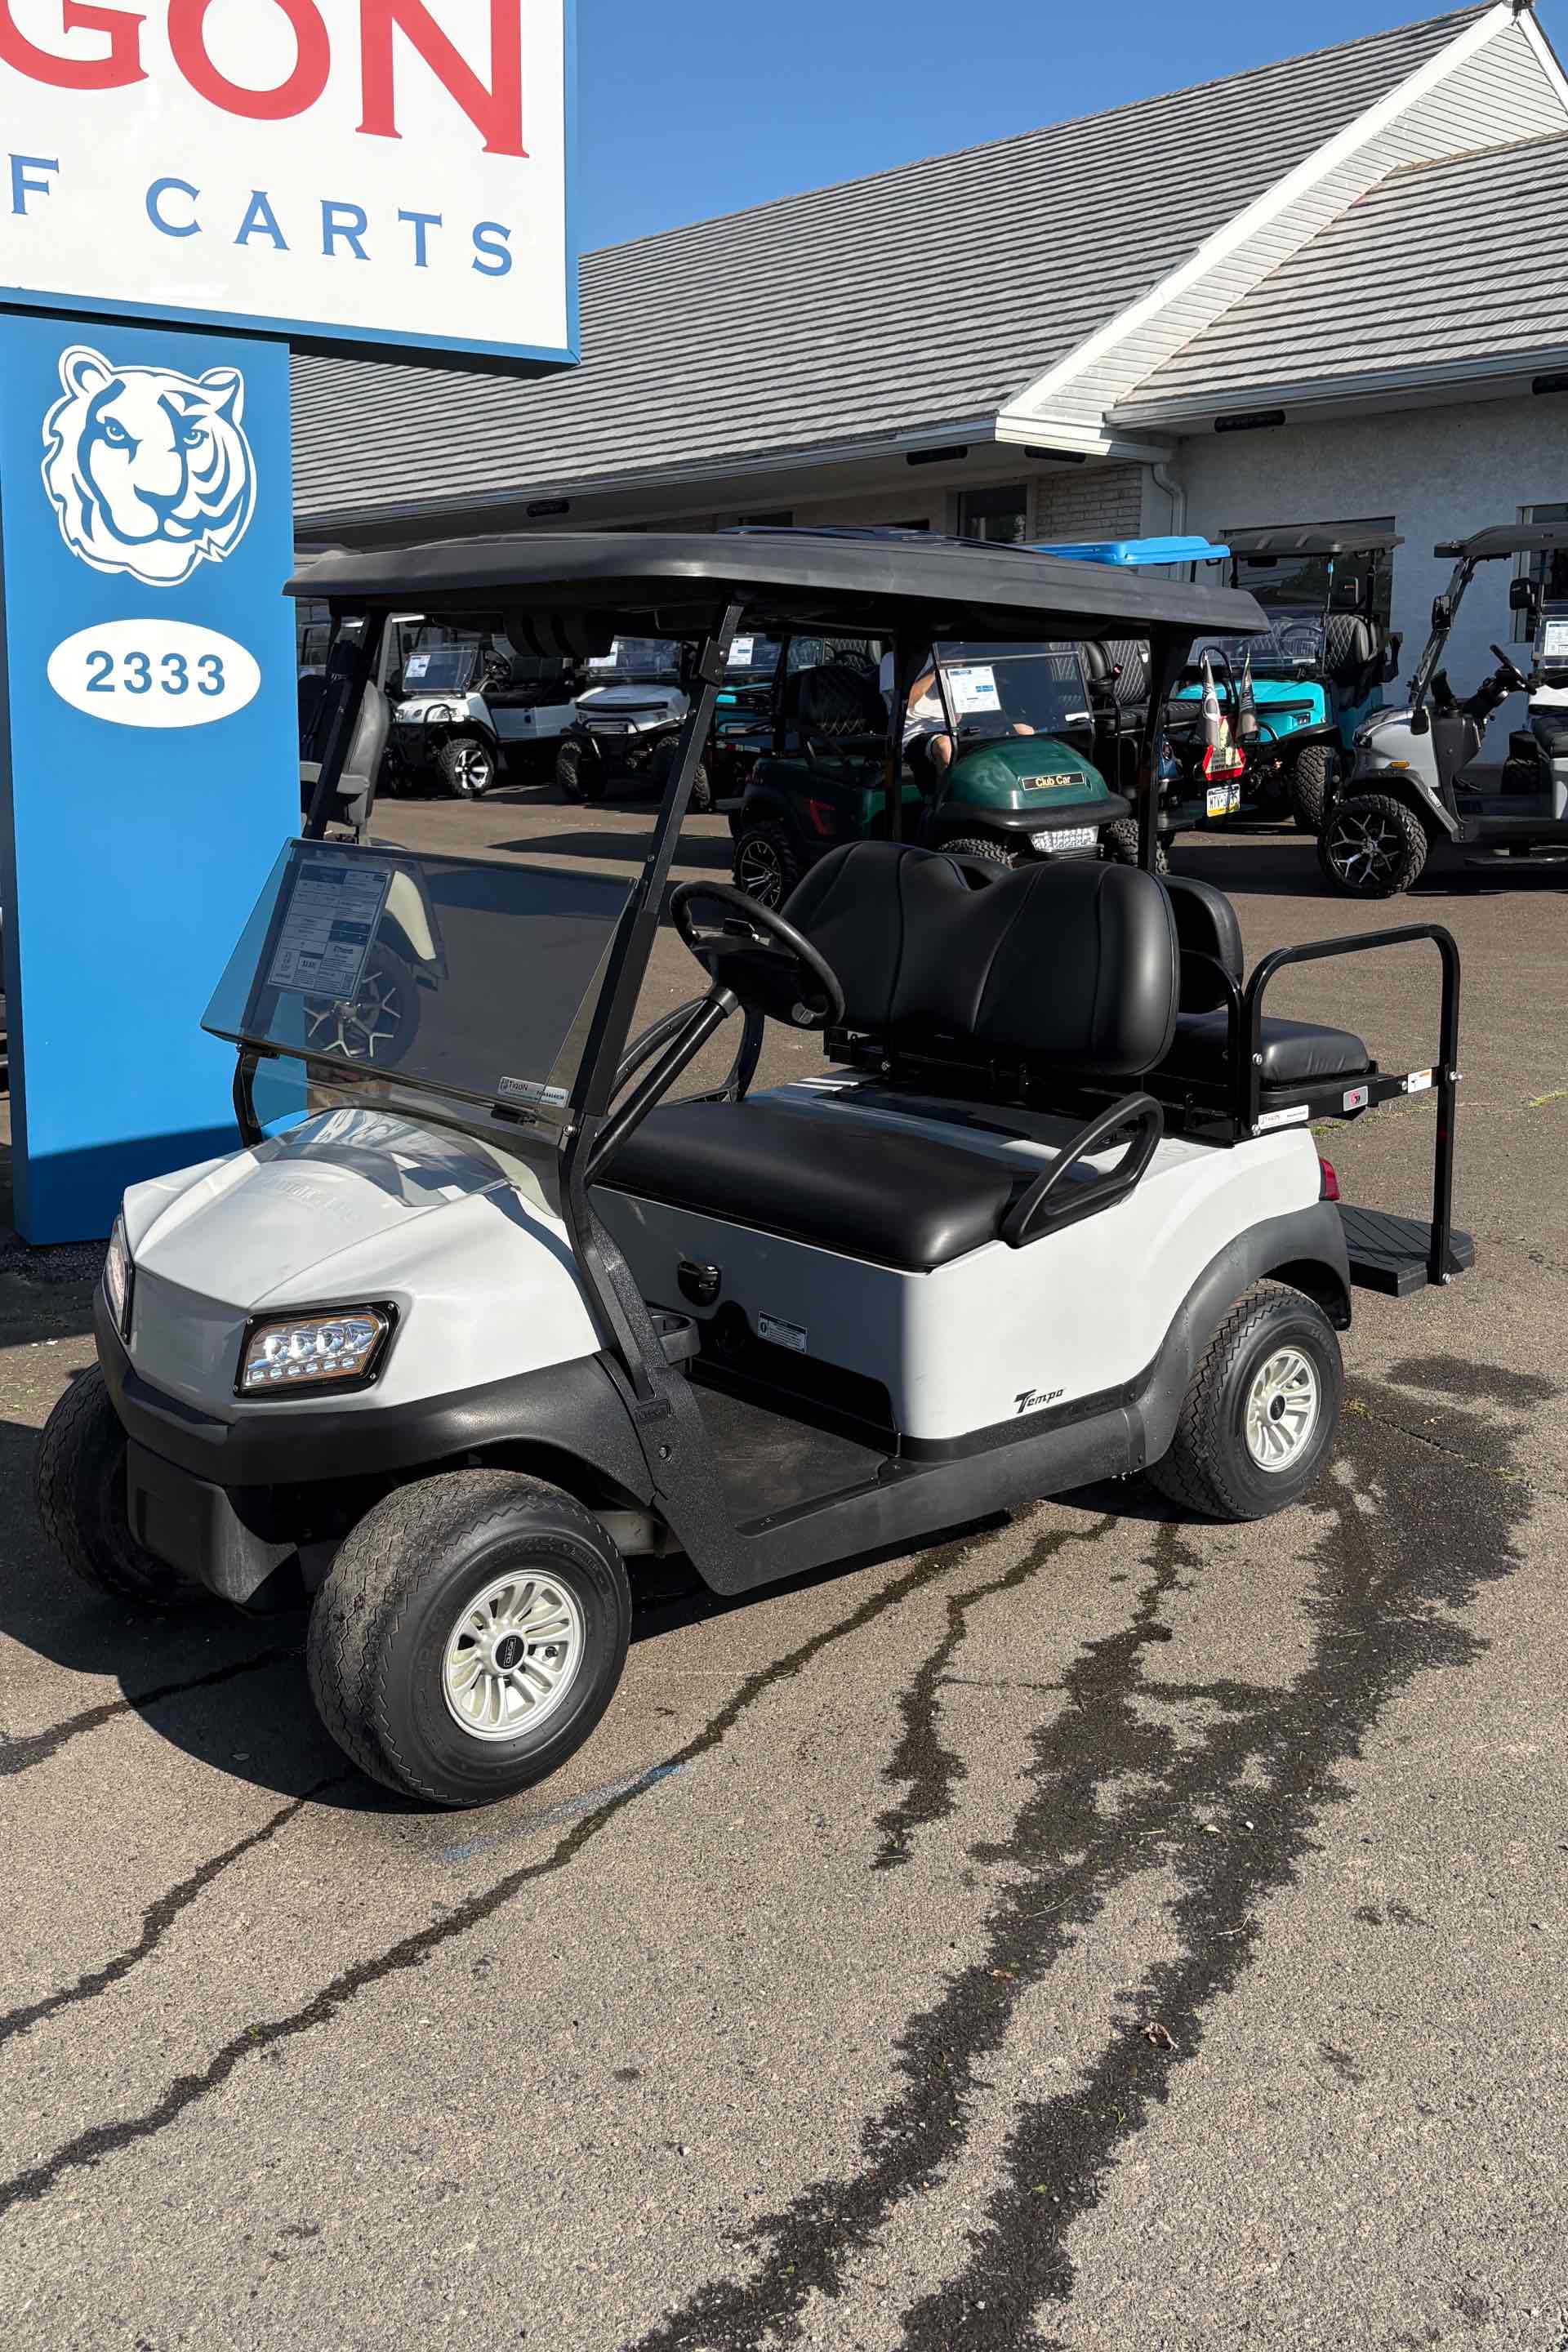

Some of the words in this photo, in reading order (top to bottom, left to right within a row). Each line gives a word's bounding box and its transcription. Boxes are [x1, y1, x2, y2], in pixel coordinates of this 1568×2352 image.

[8, 154, 60, 216] F
[145, 176, 513, 277] CARTS
[85, 650, 225, 697] 2333
[1035, 777, 1055, 787] Club
[1055, 774, 1071, 785] Car
[1013, 1388, 1064, 1414] Tempo
